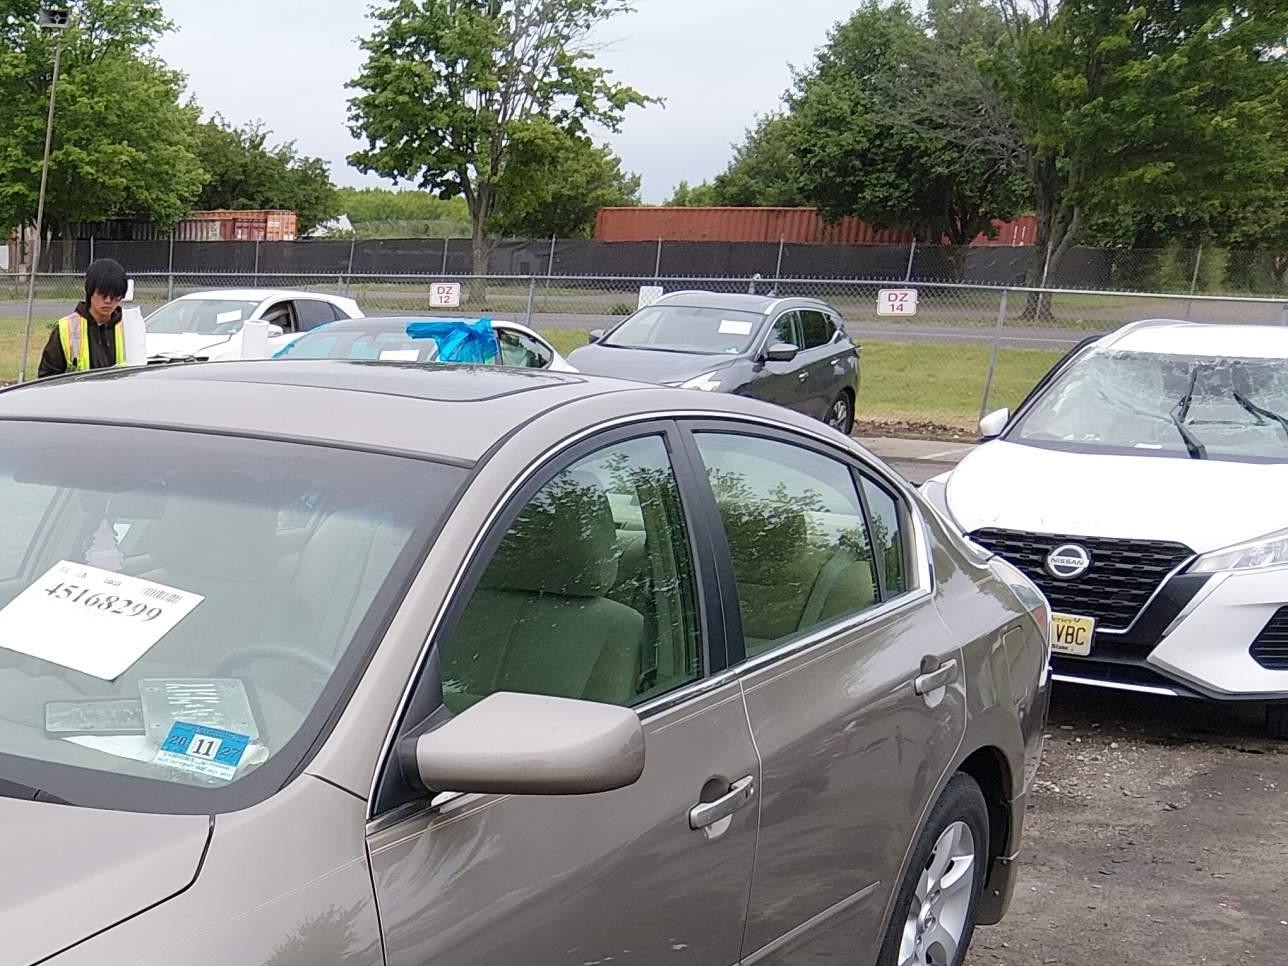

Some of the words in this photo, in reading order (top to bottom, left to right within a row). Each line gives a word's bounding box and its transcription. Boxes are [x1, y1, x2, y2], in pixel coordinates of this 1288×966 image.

[437, 286, 453, 295] DZ
[439, 295, 451, 304] 12
[888, 292, 909, 303] DZ
[889, 303, 904, 312] 14
[1050, 557, 1085, 566] NISSAN
[44, 581, 163, 623] 45168299
[1056, 623, 1087, 646] VBC
[169, 734, 188, 746] 20
[192, 738, 215, 757] 11
[219, 746, 241, 758] 27
